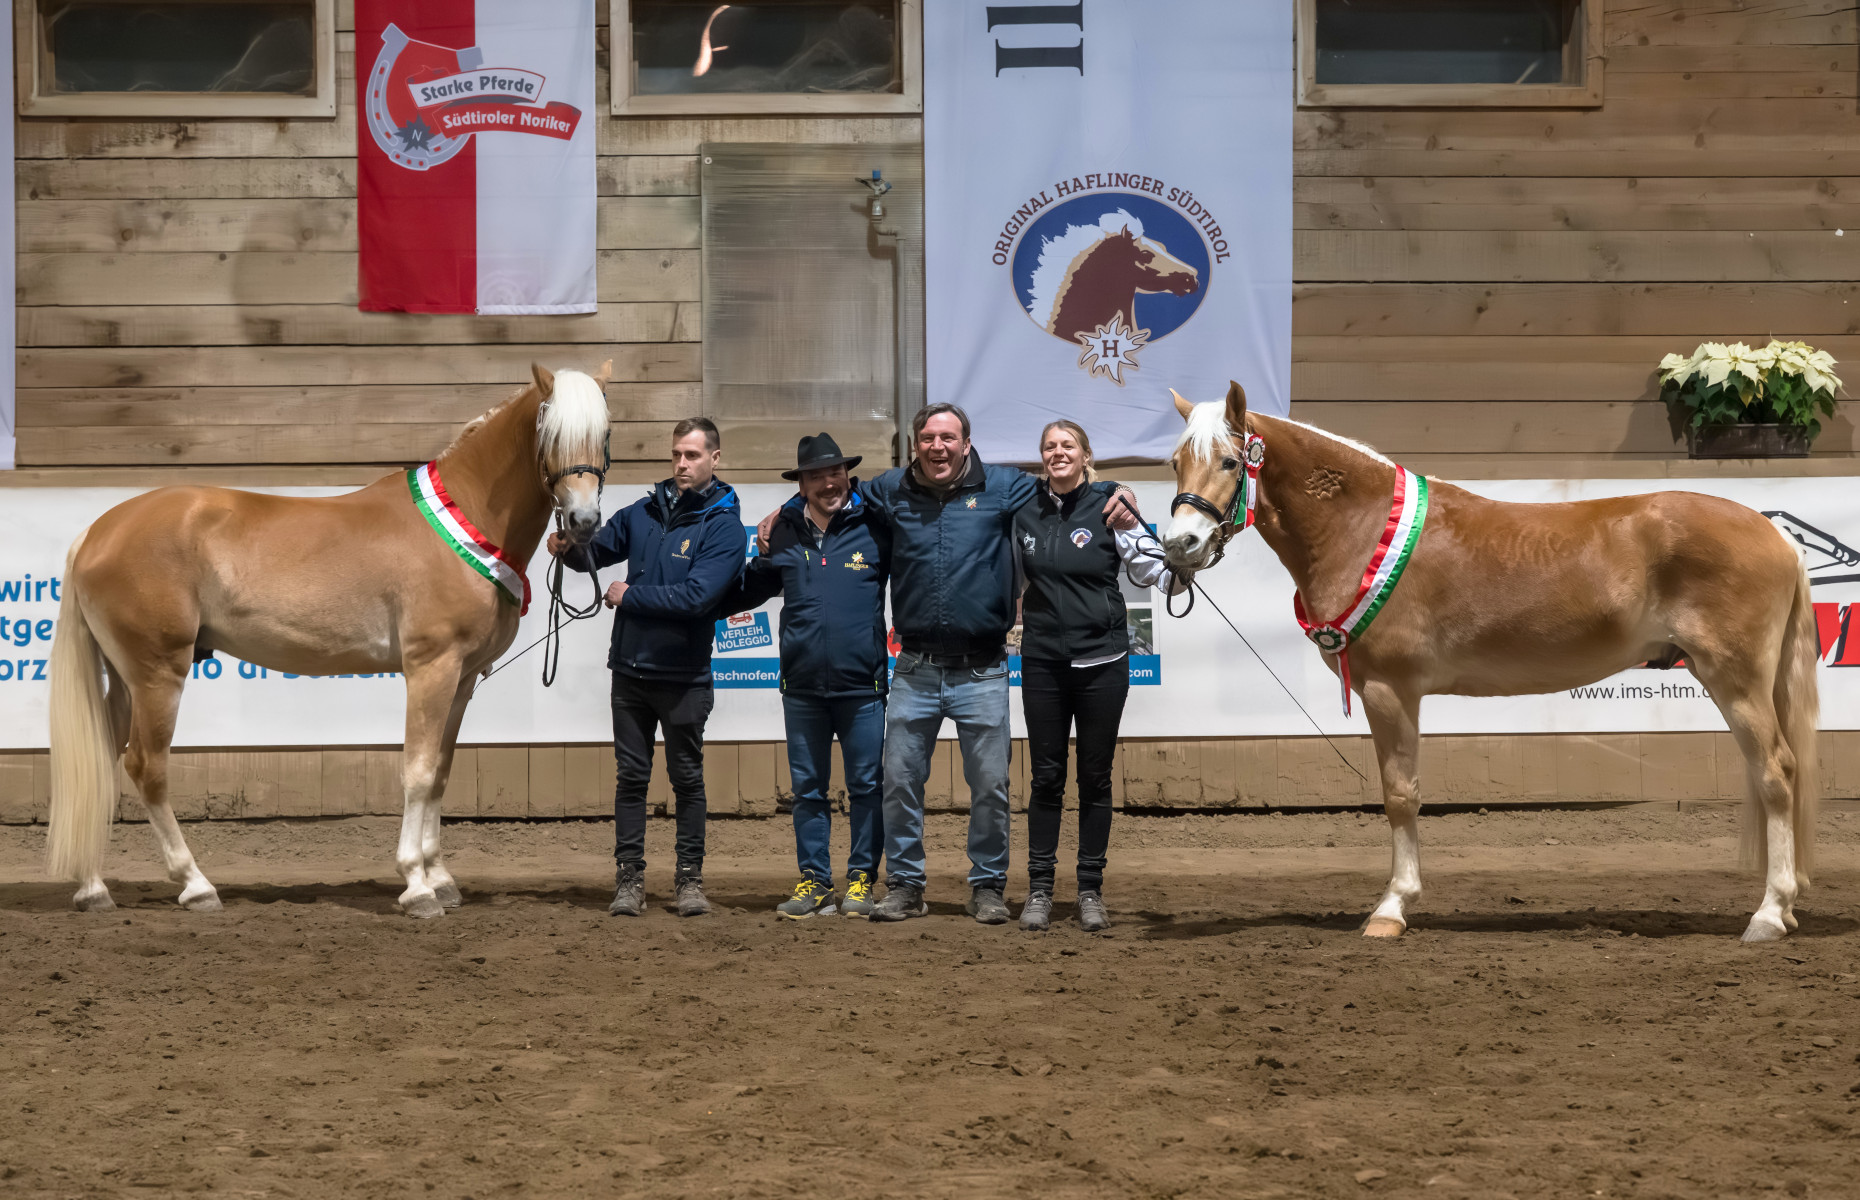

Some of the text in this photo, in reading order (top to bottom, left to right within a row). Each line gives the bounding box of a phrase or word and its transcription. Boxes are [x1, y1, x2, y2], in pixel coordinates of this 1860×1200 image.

[421, 75, 534, 102] Starke Pferde
[442, 110, 571, 133] Südtiroler Noriker
[411, 129, 422, 142] N
[992, 173, 1231, 266] ORIGINAL HAFLINGER SÜDTIROL
[1101, 339, 1120, 358] H
[721, 625, 764, 640] VERLEIH
[718, 634, 770, 651] NOLEGGIO
